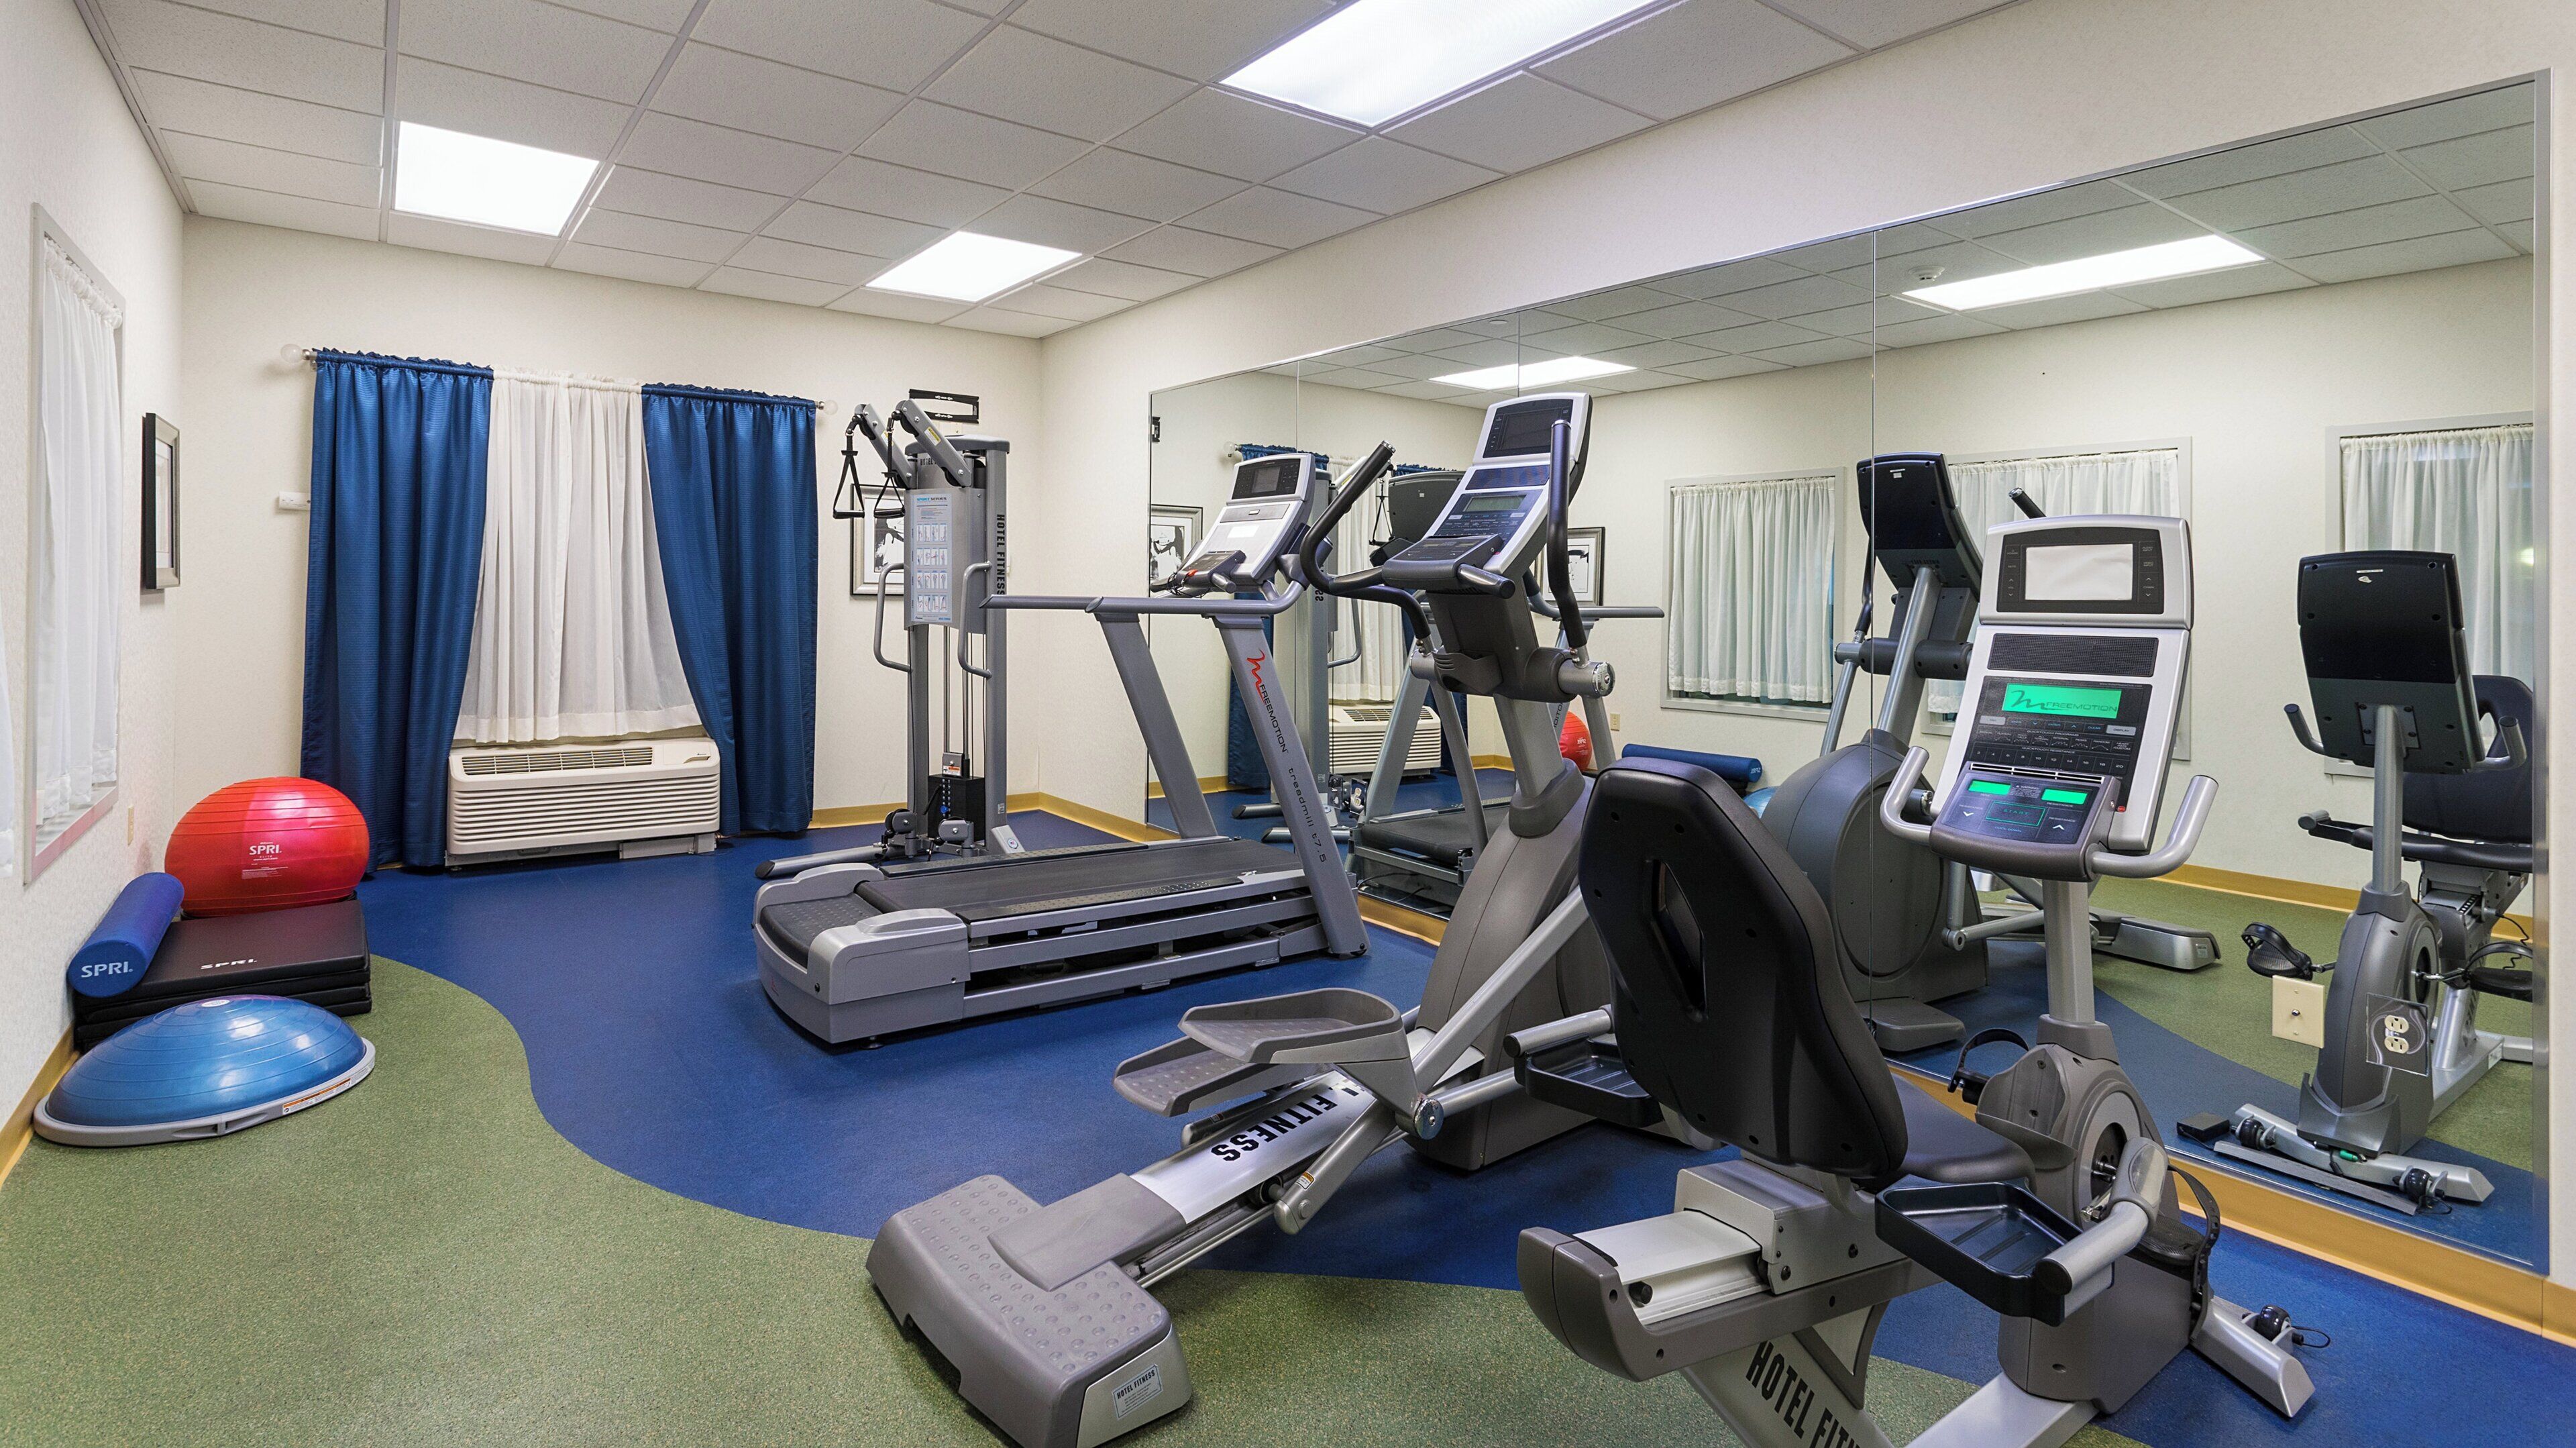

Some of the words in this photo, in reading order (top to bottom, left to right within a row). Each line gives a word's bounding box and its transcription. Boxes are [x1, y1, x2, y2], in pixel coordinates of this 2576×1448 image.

[996, 514, 1005, 548] HOTEL
[996, 552, 1005, 594] FITNESS
[1259, 684, 1287, 753] FREEMOTION
[2045, 701, 2118, 712] FREEMOTION
[1289, 768, 1314, 827] treadmill
[1312, 833, 1327, 863] t7.5
[1211, 1094, 1338, 1161] FITNESS
[1116, 1384, 1133, 1400] HOTEL
[1134, 1369, 1155, 1388] FITNESS
[1746, 1340, 1815, 1439] HOTEL
